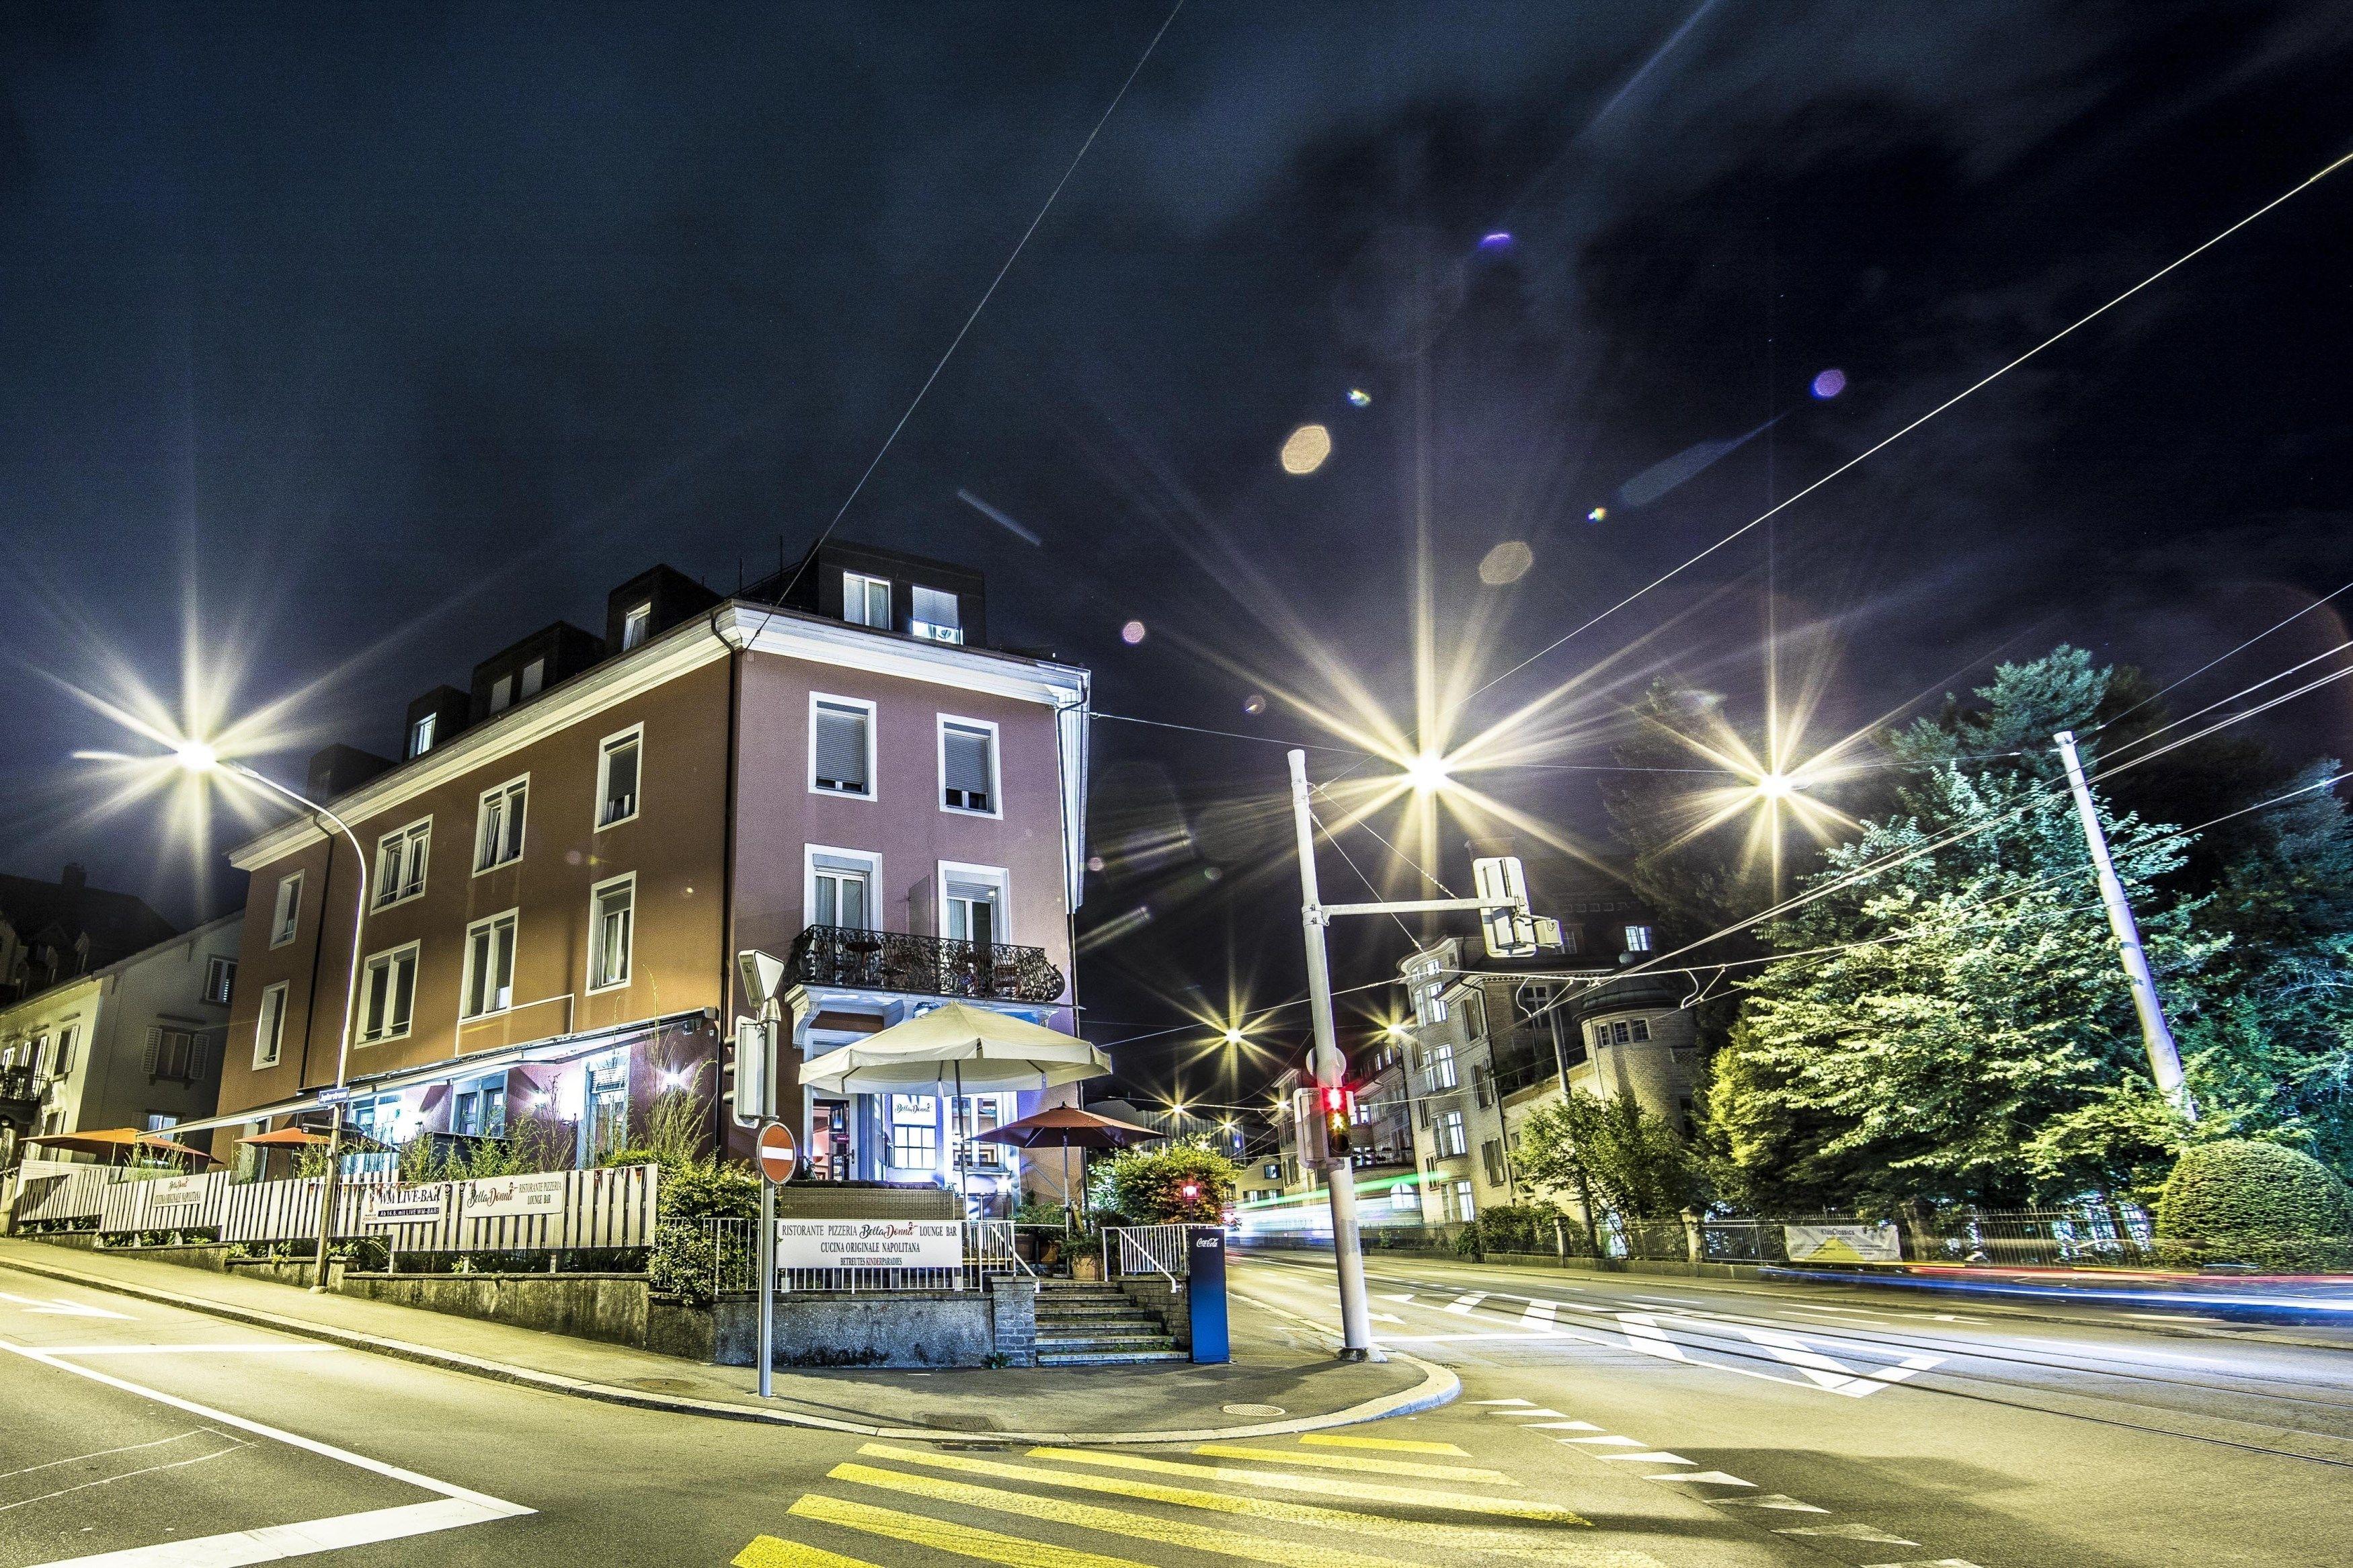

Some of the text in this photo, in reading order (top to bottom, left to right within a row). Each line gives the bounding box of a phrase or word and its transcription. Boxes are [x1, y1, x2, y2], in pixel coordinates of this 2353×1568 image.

[519, 1181, 561, 1193] RISTORANTE PIZZERIA
[378, 1188, 440, 1204] WM LIVE-BAR
[528, 1194, 551, 1205] LOUNGE BAR
[782, 1225, 824, 1236] RISTORANTE
[828, 1225, 857, 1236] PIZZERIA
[920, 1226, 943, 1237] LOUNGE
[946, 1226, 957, 1237] BAR
[820, 1242, 920, 1252] CUCINA ORIGINALE NAPOLITANA
[840, 1257, 902, 1266] BETREUTES KINDERPARADIES
